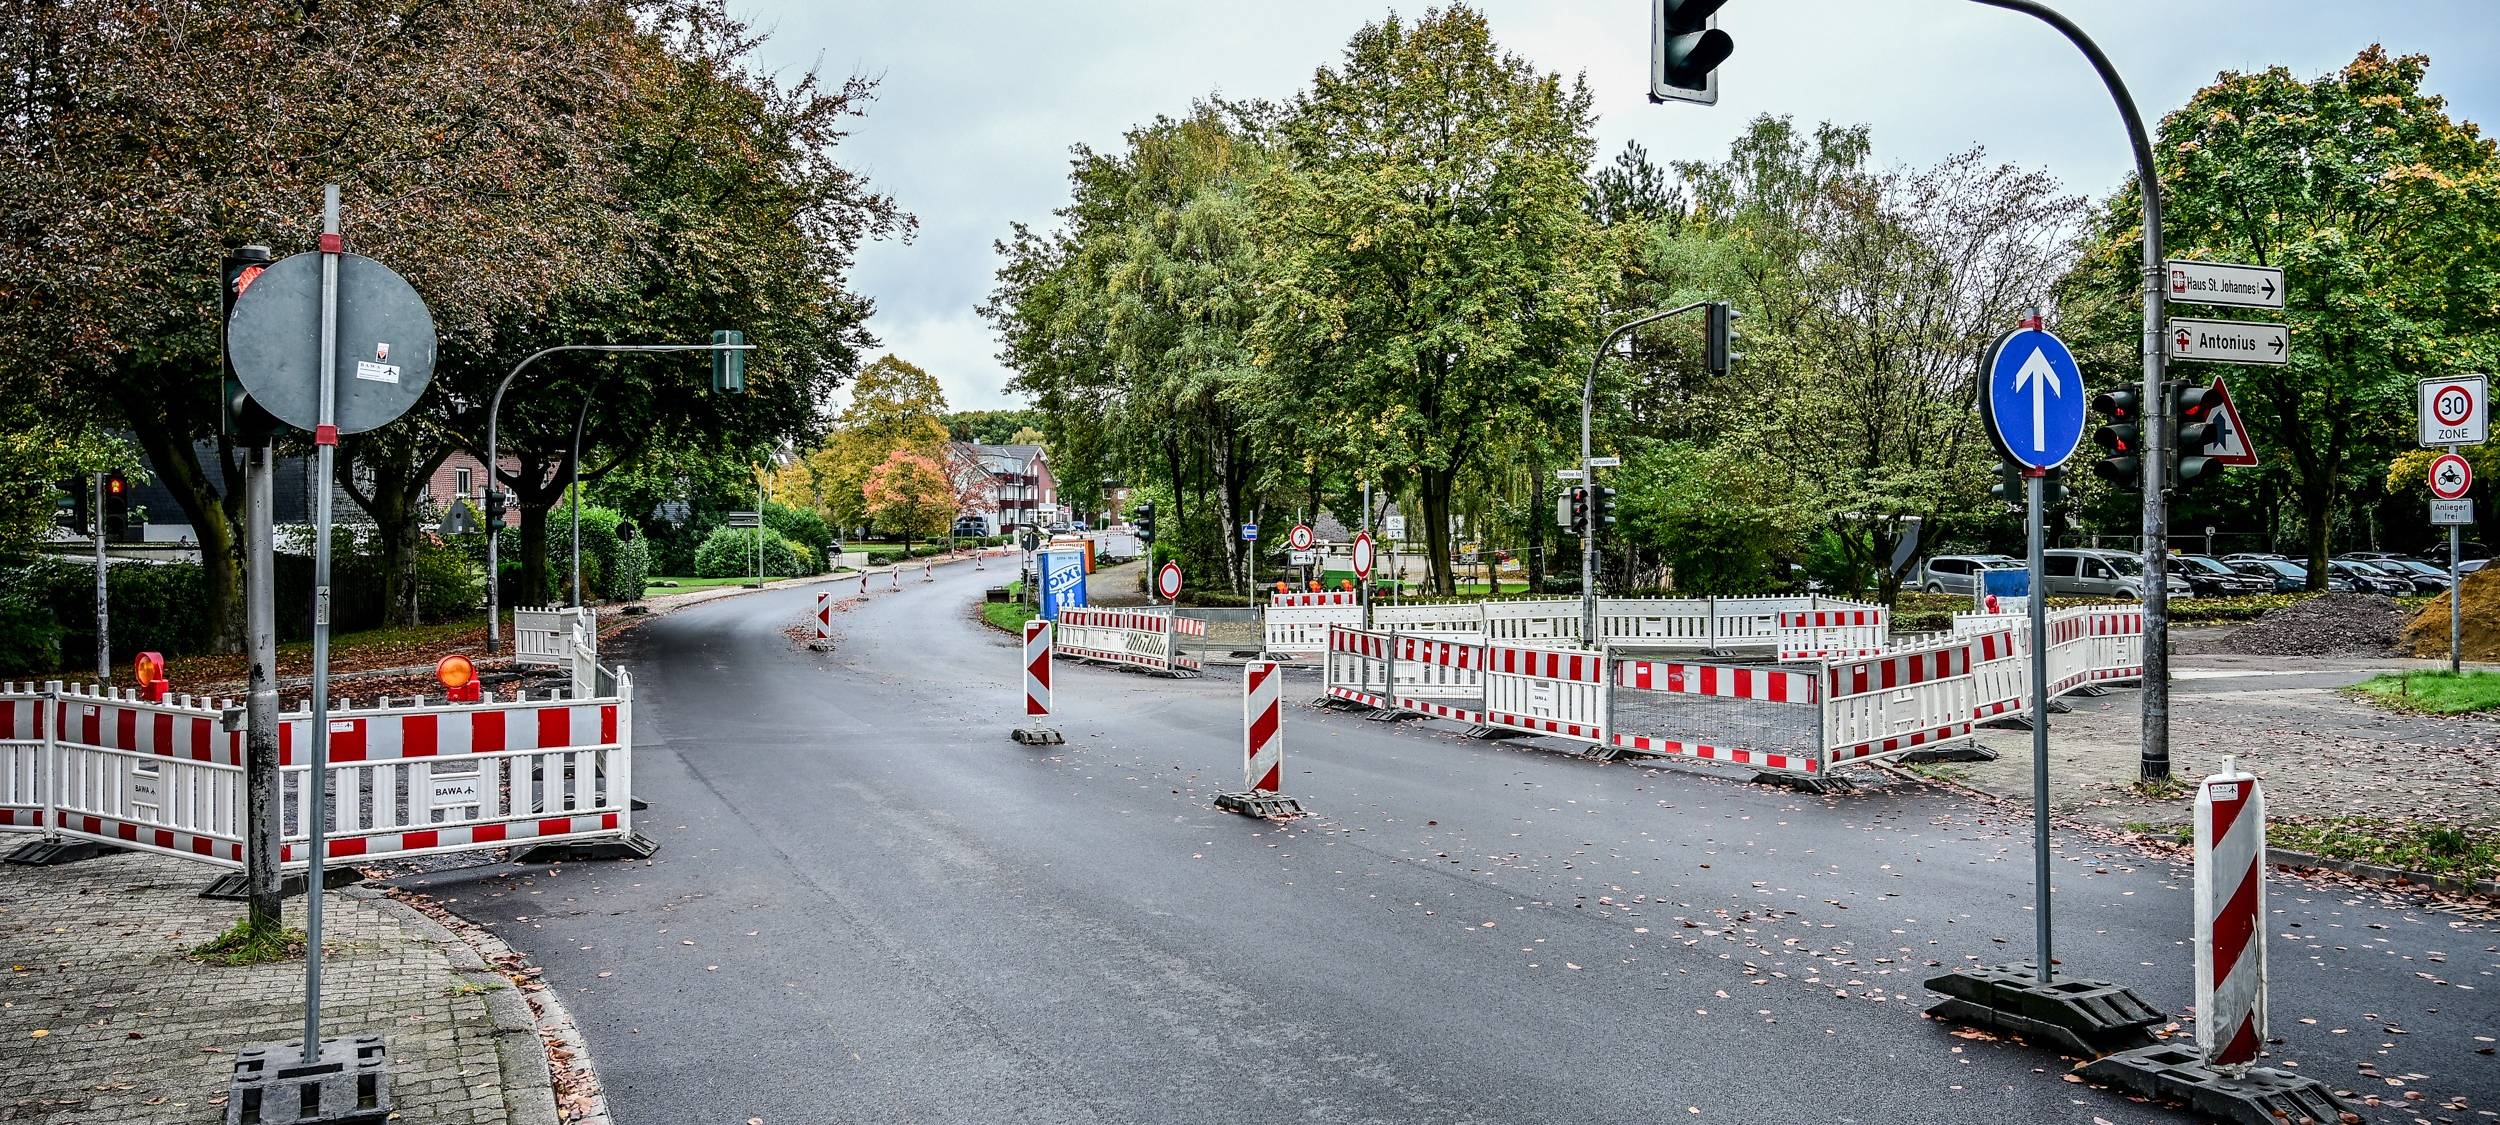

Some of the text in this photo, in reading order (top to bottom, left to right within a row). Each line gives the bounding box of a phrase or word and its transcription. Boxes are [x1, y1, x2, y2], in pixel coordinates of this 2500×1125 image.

[2187, 276, 2207, 291] Haus
[2208, 278, 2219, 292] St.
[2220, 280, 2256, 295] Johannes
[2199, 332, 2256, 351] Antonius
[2441, 396, 2464, 416] 30
[2438, 428, 2469, 440] ZONE
[2434, 503, 2467, 513] Anlieger
[2444, 512, 2458, 520] frei
[435, 786, 463, 796] BAWA
